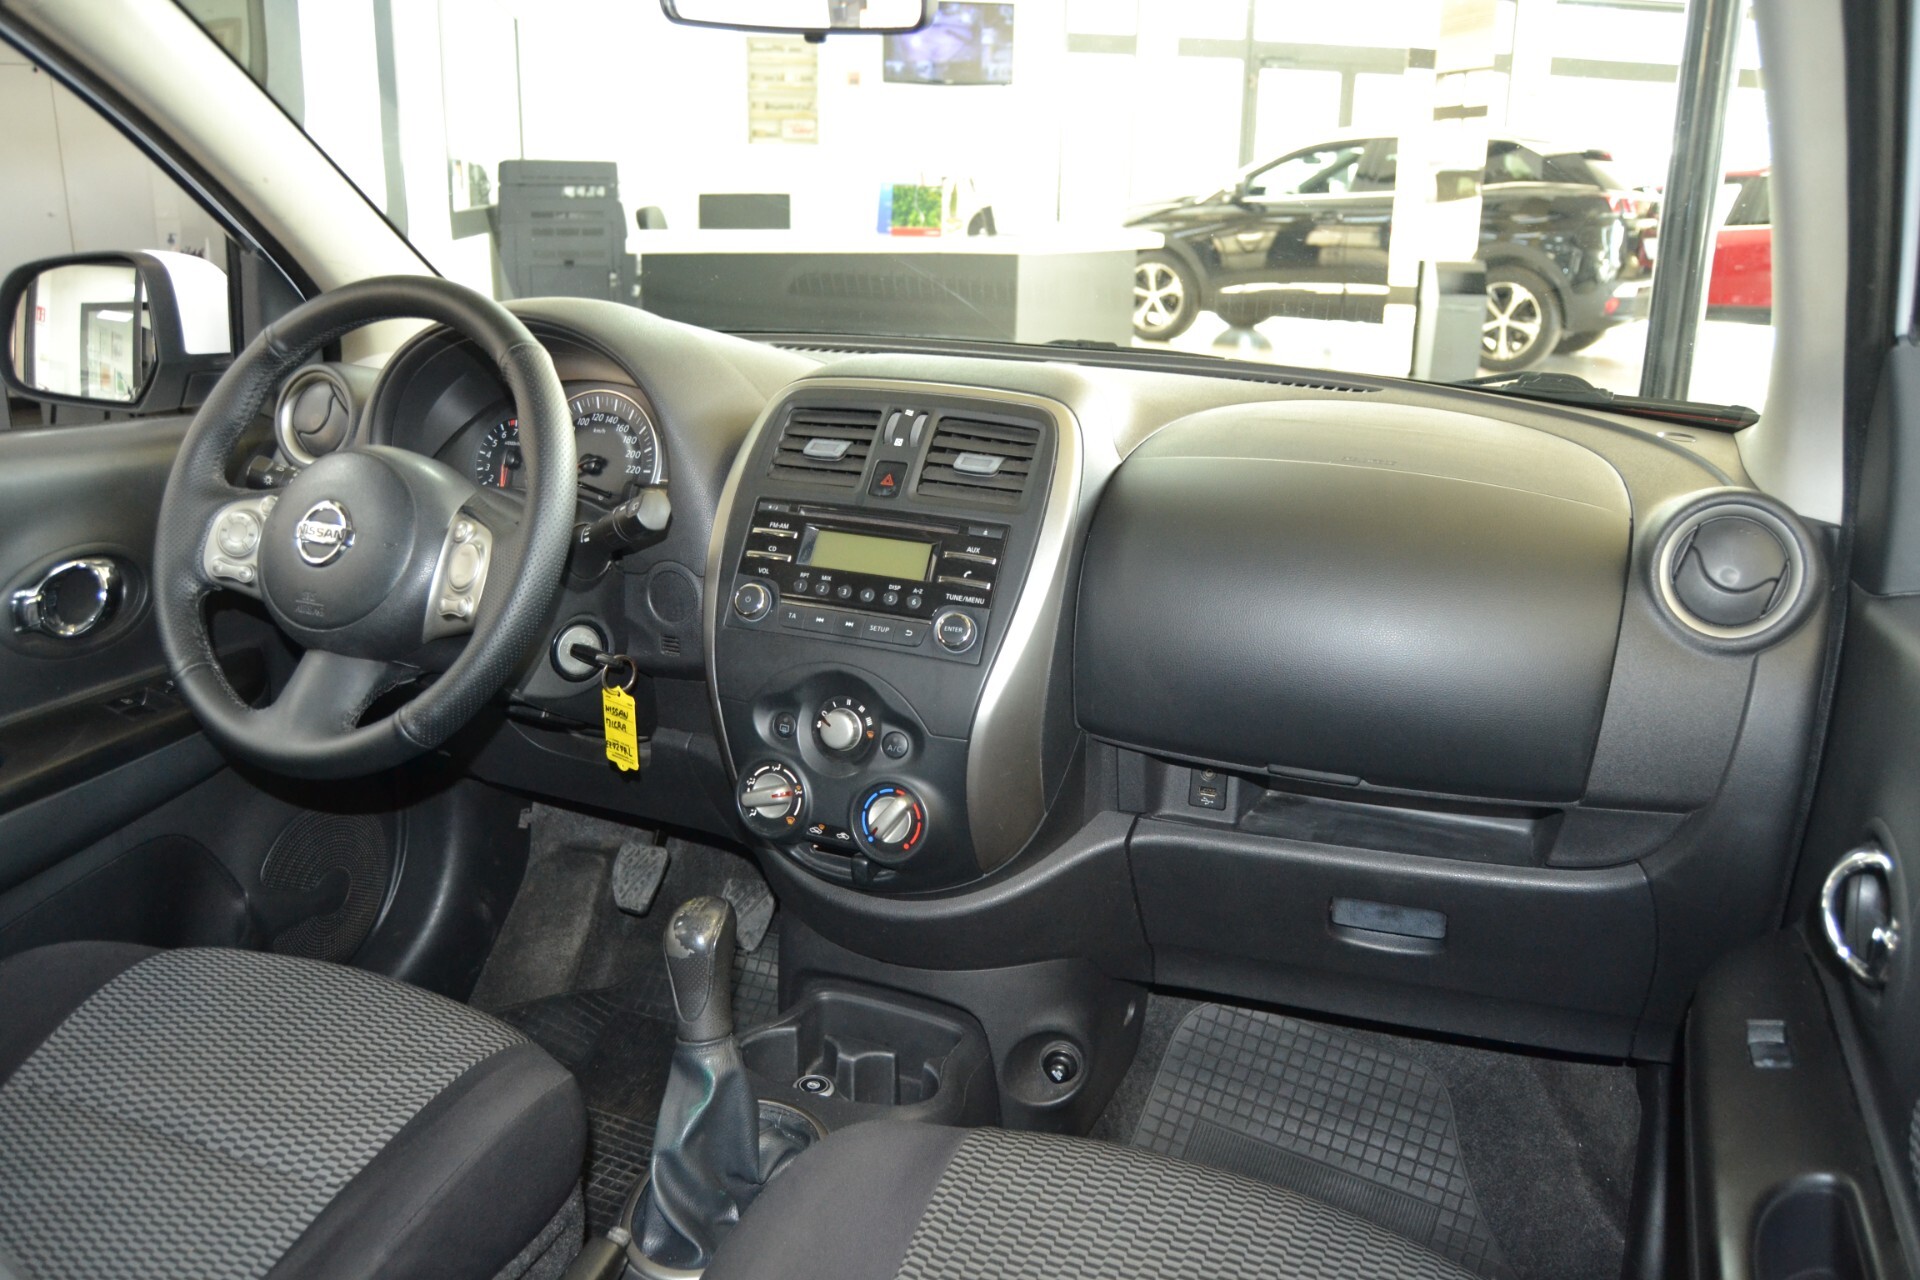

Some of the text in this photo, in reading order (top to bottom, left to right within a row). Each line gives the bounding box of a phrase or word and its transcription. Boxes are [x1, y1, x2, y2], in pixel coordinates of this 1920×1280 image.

[577, 417, 590, 426] 100
[591, 413, 605, 422] 120
[605, 415, 619, 425] 140
[615, 424, 630, 433] 160
[625, 450, 641, 459] 200
[625, 464, 641, 475] 220
[298, 523, 345, 541] NISSAN
[966, 546, 981, 554] AUX
[758, 567, 769, 575] VOL
[945, 593, 985, 605] TUNE/MENU
[869, 624, 890, 633] SETUP
[944, 625, 963, 633] ENTER
[887, 744, 902, 752] A/C
